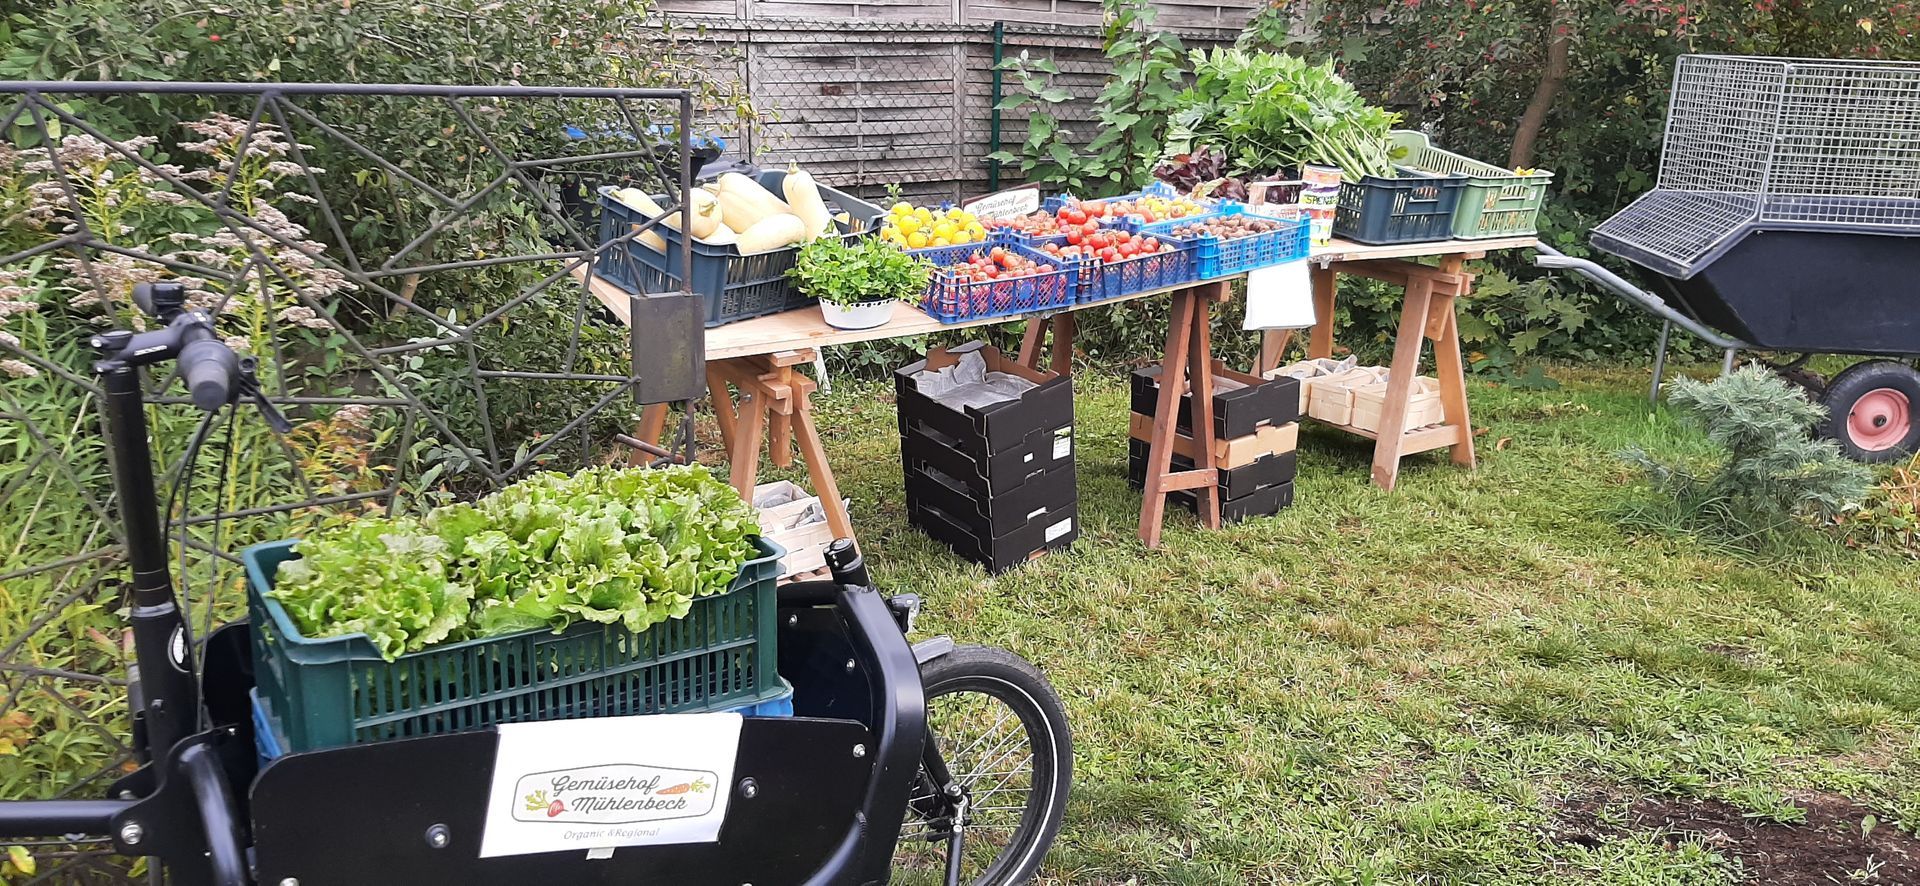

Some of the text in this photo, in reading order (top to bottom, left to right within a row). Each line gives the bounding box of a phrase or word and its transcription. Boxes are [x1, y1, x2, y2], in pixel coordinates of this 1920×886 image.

[551, 775, 661, 798] Gemüsehof
[571, 796, 688, 814] Mühlenbeck
[563, 829, 605, 841] Organic
